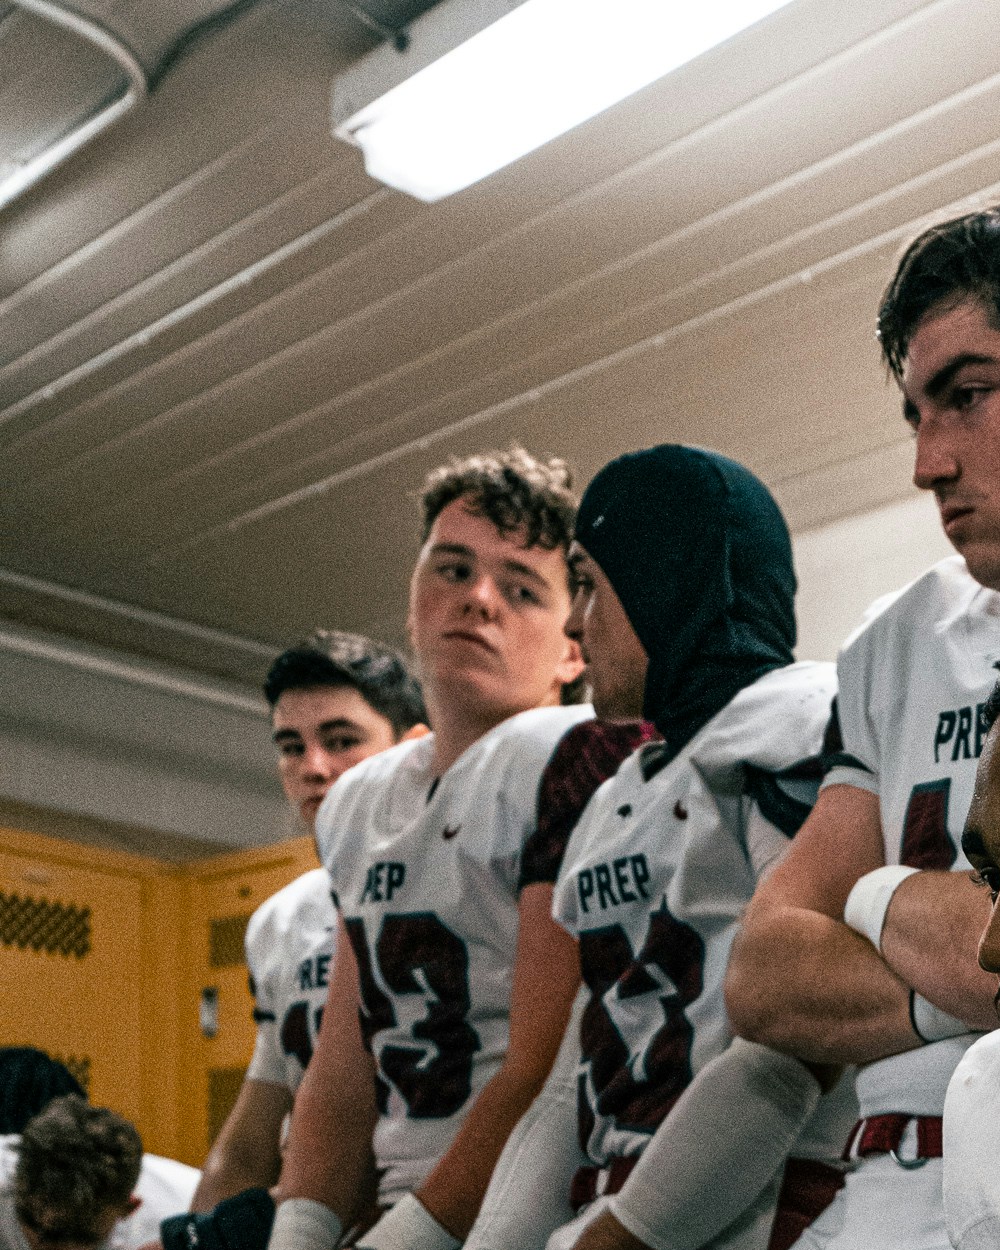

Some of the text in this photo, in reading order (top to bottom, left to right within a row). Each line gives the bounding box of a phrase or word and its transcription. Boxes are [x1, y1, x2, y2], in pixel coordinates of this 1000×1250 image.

[934, 703, 990, 764] PRE
[360, 861, 406, 903] EP
[578, 853, 651, 914] PREP
[295, 953, 332, 992] RE
